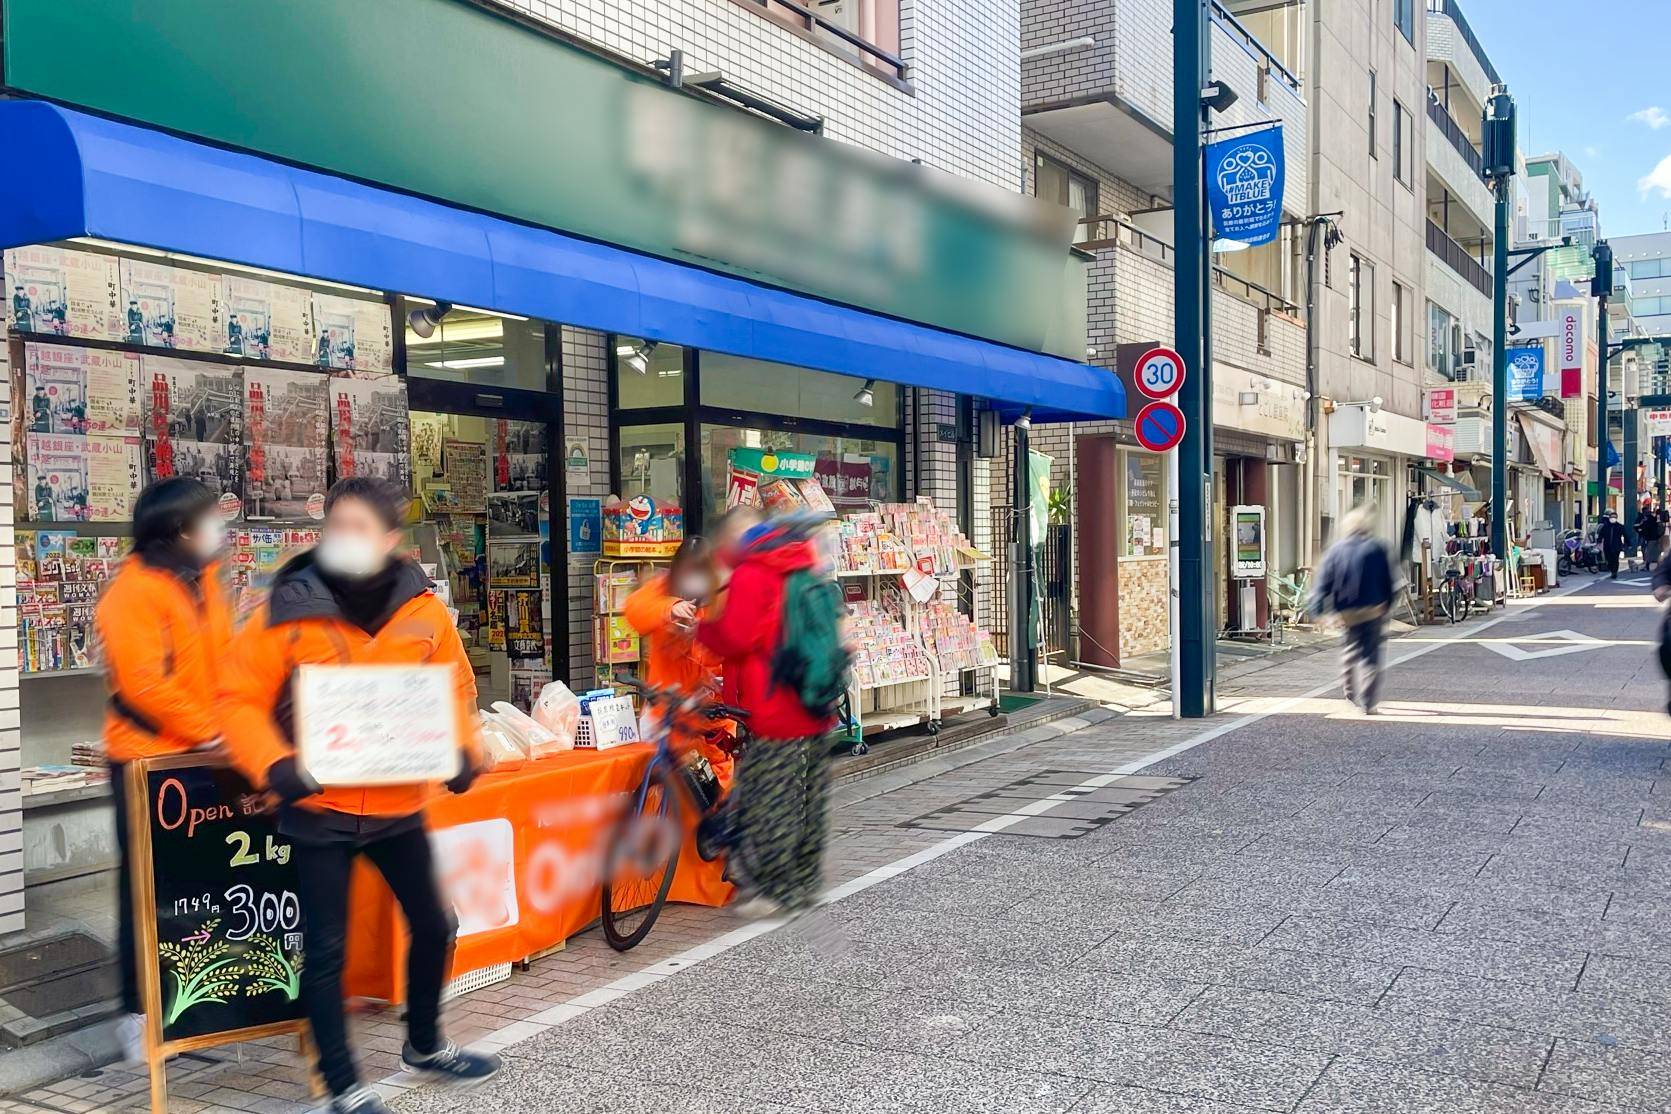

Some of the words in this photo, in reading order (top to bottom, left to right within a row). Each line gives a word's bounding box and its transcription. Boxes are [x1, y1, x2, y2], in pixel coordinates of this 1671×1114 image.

[1228, 180, 1270, 194] #MAKE
[1229, 189, 1268, 203] ITBLUE
[1221, 199, 1277, 219] ありがとう!
[1565, 315, 1577, 362] docomo
[1146, 362, 1174, 386] 30
[157, 777, 234, 838] Open
